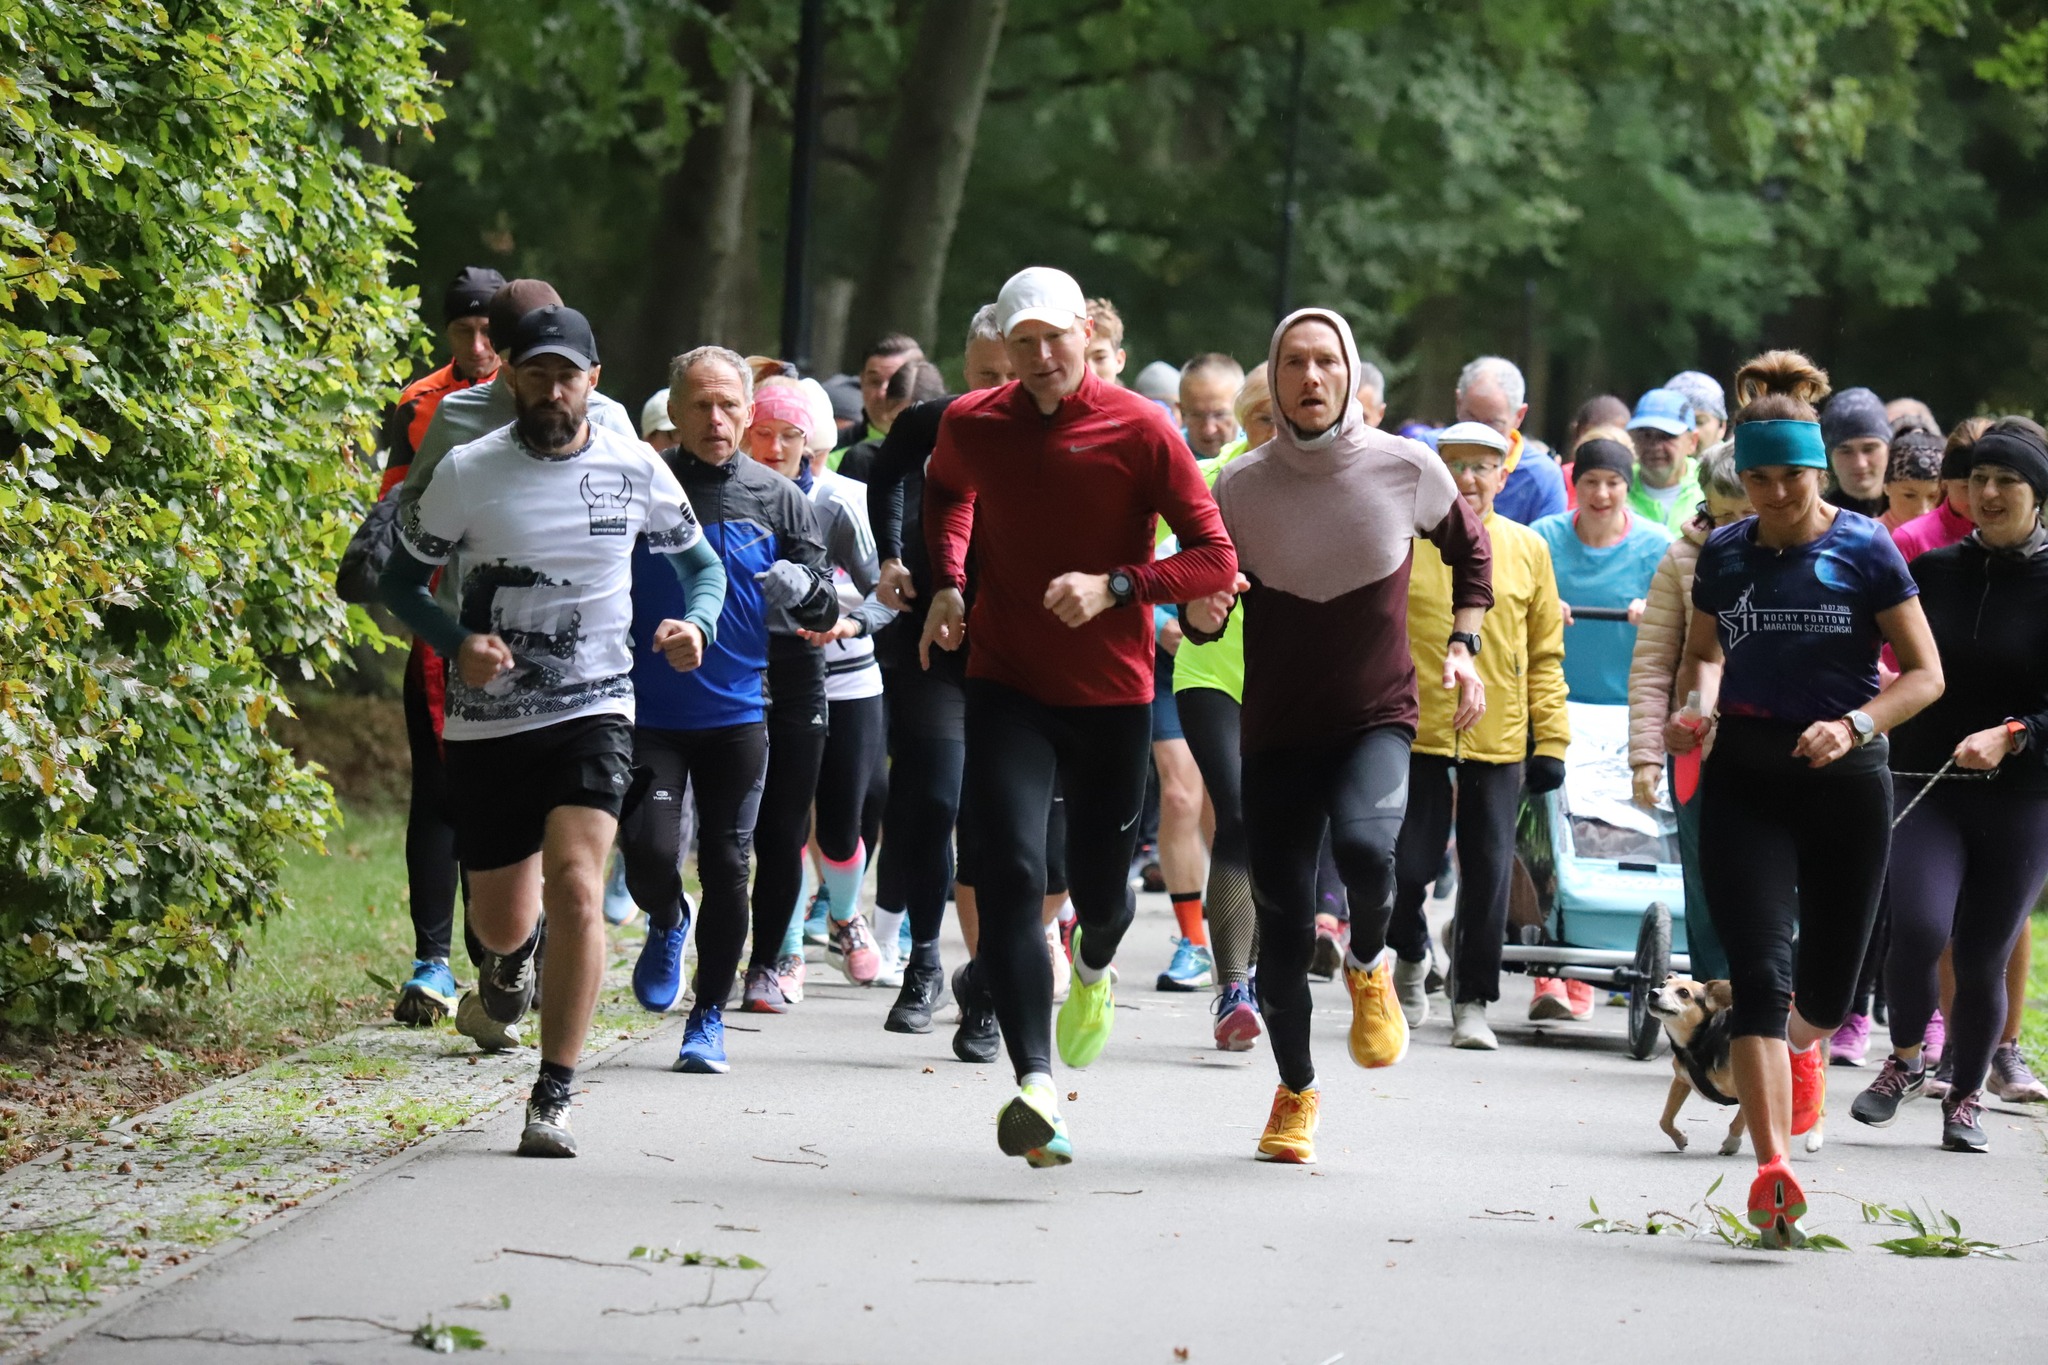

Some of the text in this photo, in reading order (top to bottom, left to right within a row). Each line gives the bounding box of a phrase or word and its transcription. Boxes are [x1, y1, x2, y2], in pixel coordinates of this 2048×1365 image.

[1763, 613, 1851, 625] NOCNY PORTOWY
[1763, 623, 1803, 632] MARATON
